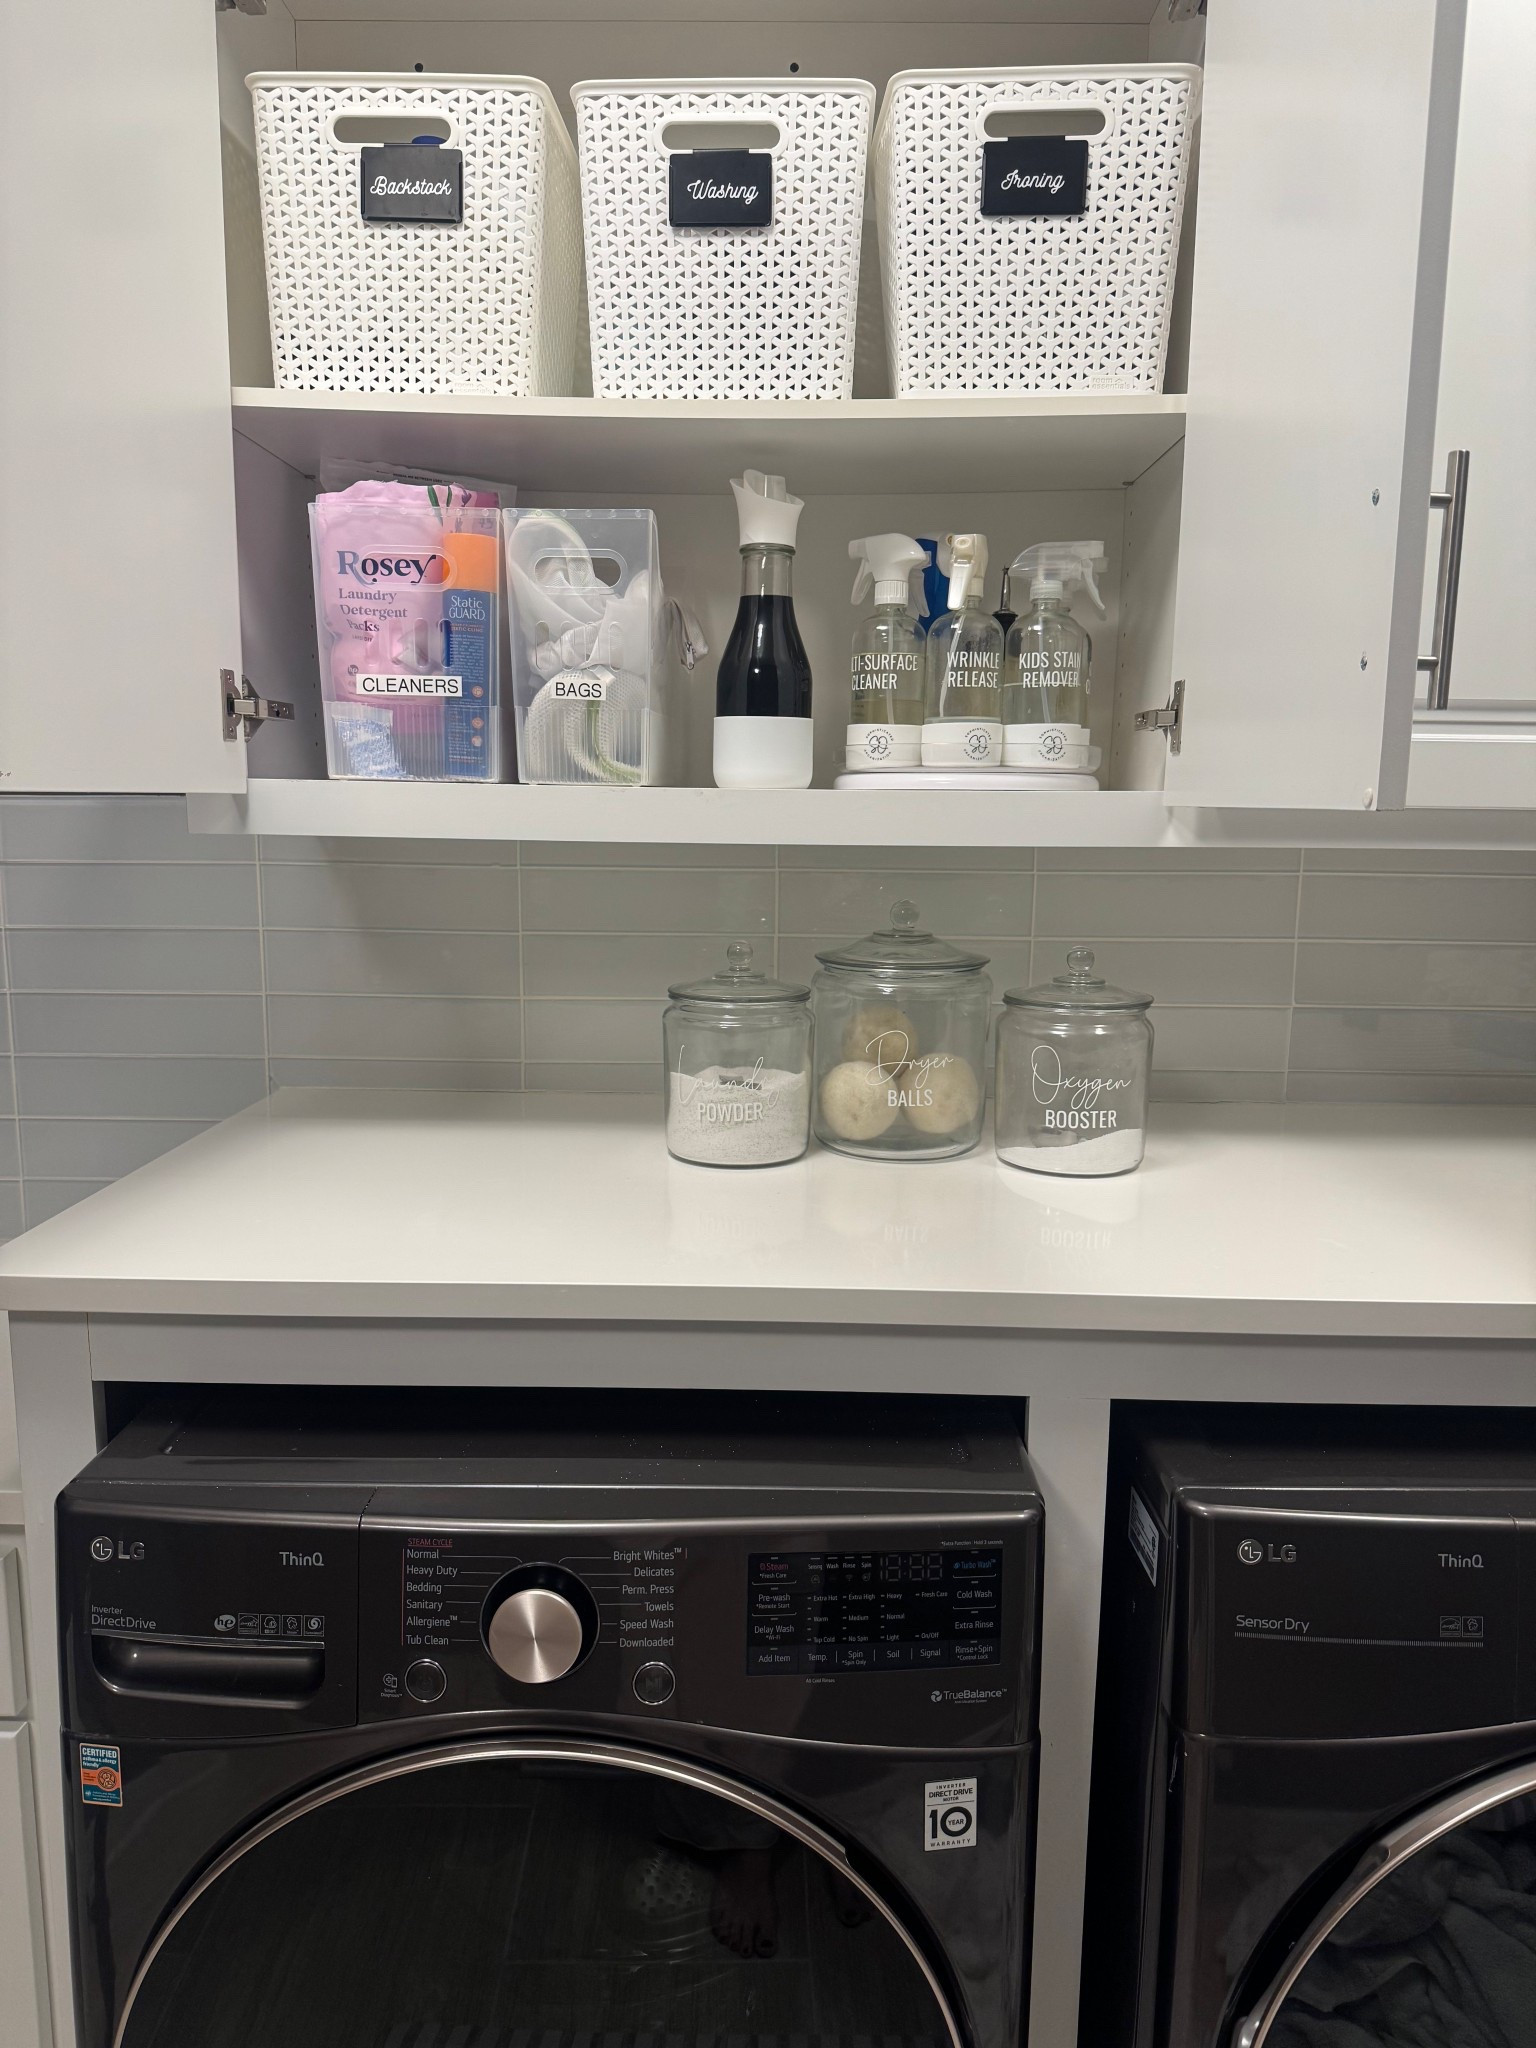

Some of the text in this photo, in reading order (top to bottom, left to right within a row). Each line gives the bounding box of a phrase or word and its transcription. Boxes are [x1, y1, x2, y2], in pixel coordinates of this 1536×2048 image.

[369, 175, 452, 196] Backstock
[1000, 168, 1065, 194] Ironing
[686, 178, 759, 205] Washing
[336, 550, 437, 586] Rosey
[338, 588, 397, 604] Laundry
[451, 595, 483, 609] Static
[340, 604, 408, 621] Detergent
[448, 607, 486, 621] GUARD
[947, 651, 1000, 670] WRINKLE
[1019, 651, 1081, 670] KIDS STAIN
[362, 677, 459, 694] CLEANERS
[851, 673, 898, 691] CLEANER
[947, 670, 998, 689] RELEASE
[1022, 670, 1079, 689] REMOVER
[555, 682, 602, 698] BAGS
[865, 1030, 954, 1089] Dryer
[1031, 1045, 1132, 1110] Oxygen
[887, 1089, 933, 1107] BALLS
[697, 1102, 764, 1122] POWDER
[1045, 1109, 1117, 1129] BOOSTER
[408, 1538, 453, 1546] STEAM CYCLE
[279, 1552, 325, 1567] ThinQ
[406, 1548, 440, 1559] Normal
[613, 1548, 682, 1564] Bright Whites™
[1437, 1553, 1485, 1568] ThinQ
[406, 1564, 458, 1578] Heavy Duty
[633, 1566, 675, 1577] Delicates
[766, 1562, 789, 1571] Steam
[406, 1581, 442, 1595] Bedding
[622, 1584, 675, 1595] Perm. Press
[956, 1590, 993, 1599] Cold Wash
[758, 1593, 791, 1602] Pre-wash
[91, 1604, 124, 1615] Inverter
[406, 1598, 443, 1612] Sanitary
[644, 1601, 674, 1612] Towels
[406, 1615, 458, 1629] Allergiene™
[619, 1618, 674, 1631] Speed Wash
[955, 1620, 994, 1629] Extra Rinse
[754, 1625, 795, 1635] Delay Wash
[405, 1634, 449, 1645] Tub Clean
[619, 1636, 674, 1648] Downloaded
[847, 1650, 864, 1659] Spin
[886, 1650, 900, 1658] Soil
[920, 1648, 941, 1658] Signal
[955, 1644, 993, 1654] Rinse+Spin
[758, 1654, 791, 1663] Add Item
[807, 1653, 828, 1662] Temp.
[82, 1747, 117, 1758] CERTIFIED
[928, 1787, 973, 1798] DIRECT DRIVE
[936, 1782, 966, 1790] INVERTER
[929, 1806, 972, 1839] 10
[948, 1818, 965, 1826] YEAR
[930, 1838, 971, 1847] WARRANTY
